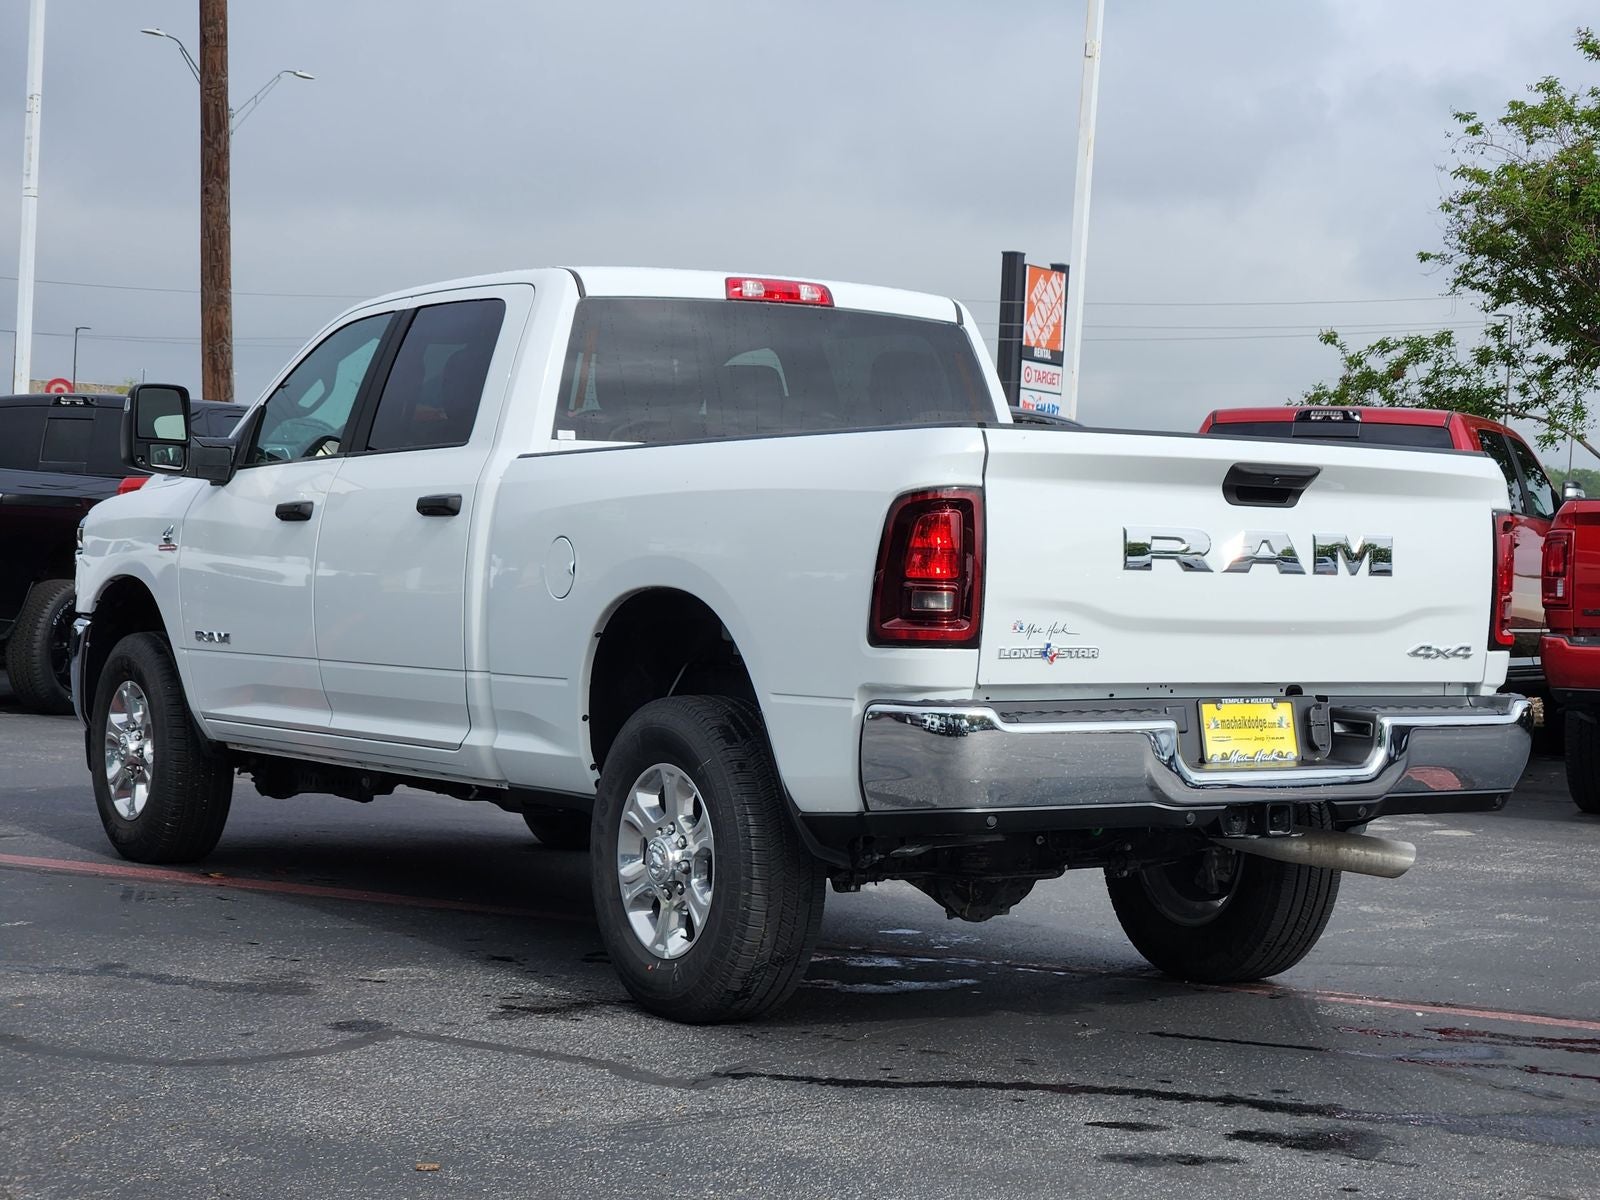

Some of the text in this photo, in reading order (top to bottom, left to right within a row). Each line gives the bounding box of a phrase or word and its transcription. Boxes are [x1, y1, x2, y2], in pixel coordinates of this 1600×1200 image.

[1030, 274, 1047, 306] THE
[1025, 271, 1063, 347] HOME
[1040, 297, 1063, 348] DEPOT
[1033, 347, 1052, 359] RENTAL
[1033, 369, 1061, 386] TARGET
[1123, 526, 1393, 577] RAM
[195, 630, 231, 644] RAM
[1025, 623, 1043, 640] Mac
[999, 648, 1100, 660] LONE STAR
[1405, 645, 1473, 660] 4x4
[1228, 749, 1249, 763] Mac
